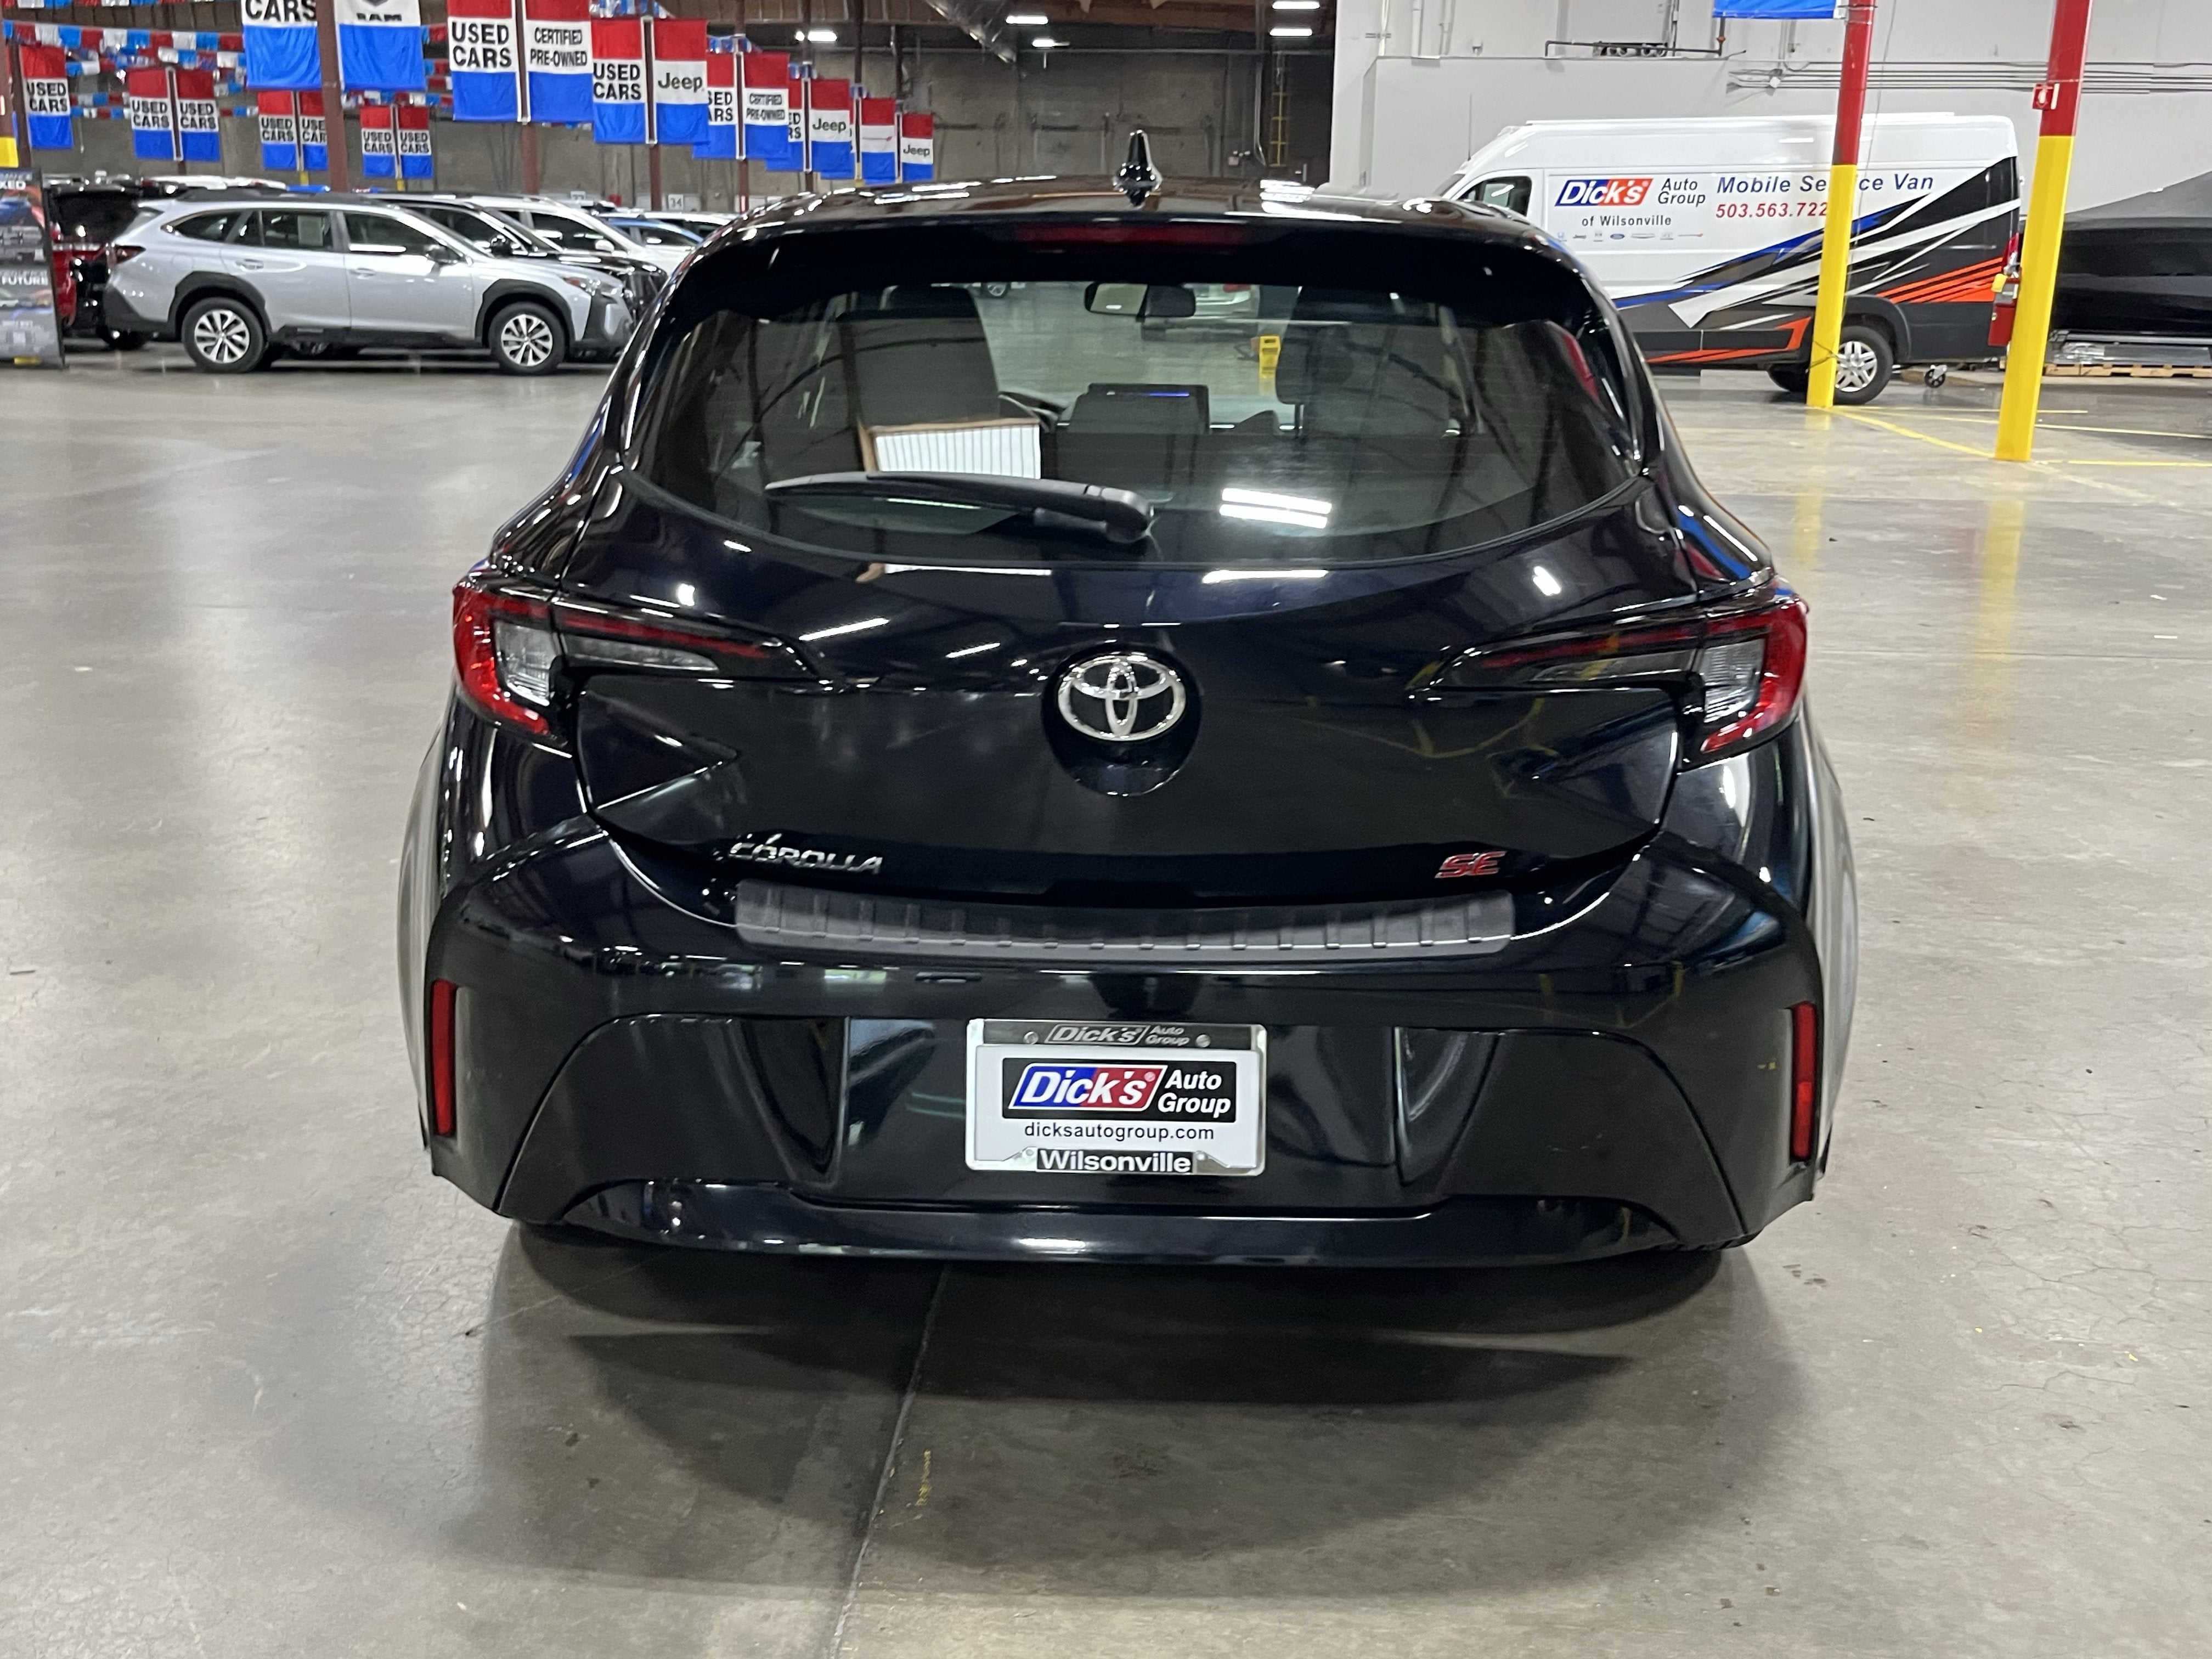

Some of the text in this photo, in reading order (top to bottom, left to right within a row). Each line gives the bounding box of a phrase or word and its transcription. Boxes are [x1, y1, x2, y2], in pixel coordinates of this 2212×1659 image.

[452, 22, 509, 44] USED
[534, 27, 582, 45] CERTIFIED
[453, 46, 512, 67] CARS
[530, 48, 587, 67] PRE-OWNED
[593, 63, 640, 81] USED
[27, 82, 66, 97] USED
[658, 72, 702, 93] Jeep
[593, 82, 641, 100] CARS
[29, 99, 69, 113] CARS
[132, 101, 167, 114] USED
[180, 102, 214, 115] USED
[133, 115, 170, 129] CARS
[180, 116, 216, 129] CARS
[261, 118, 292, 130] USED
[302, 119, 325, 131] USE
[812, 119, 847, 134] Jeep
[262, 130, 294, 142] CARS
[302, 131, 326, 143] CAR
[364, 132, 391, 142] USED
[400, 131, 428, 142] USED
[364, 143, 393, 154] CARS
[400, 143, 430, 154] CARS
[903, 145, 930, 157] Jeep
[1661, 178, 1698, 190] Auto
[1717, 173, 1934, 194] Mobile Sece Van
[1560, 180, 1643, 205] Dick's
[1657, 191, 1706, 207] Group
[1716, 202, 1828, 218] 503.563.722
[1582, 215, 1672, 227] of Wilsonville
[729, 842, 883, 874] COROLLA
[1434, 851, 1507, 878] SE
[1052, 1026, 1139, 1042] Dick's
[1152, 1025, 1184, 1035] Auto
[1145, 1035, 1190, 1047] Group
[1020, 1070, 1148, 1105] Dick's
[1165, 1070, 1222, 1091] Auto
[1158, 1093, 1232, 1118] Group
[1024, 1122, 1214, 1142] dicksautogroup.com
[1039, 1150, 1192, 1173] Wilsonville
